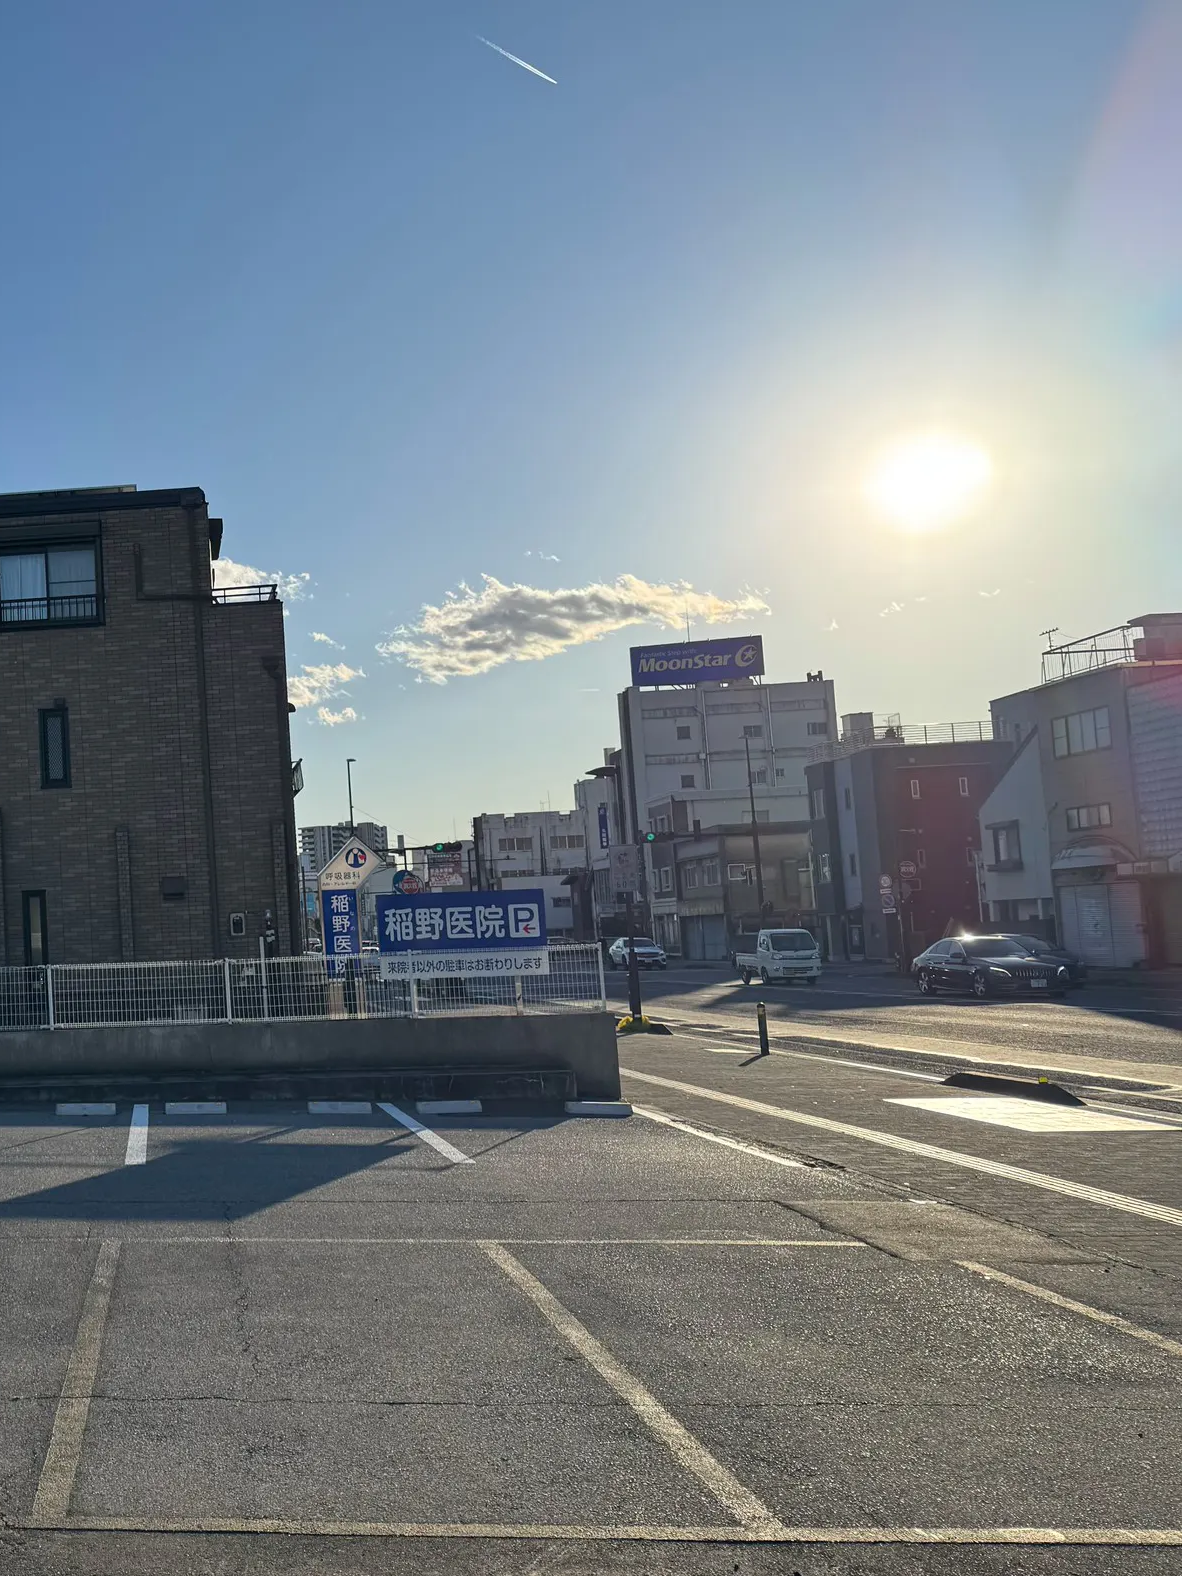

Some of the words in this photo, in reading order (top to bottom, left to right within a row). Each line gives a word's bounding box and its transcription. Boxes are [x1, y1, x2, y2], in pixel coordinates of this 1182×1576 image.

[638, 654, 732, 673] MoonStar
[384, 904, 505, 942] 稲野医院
